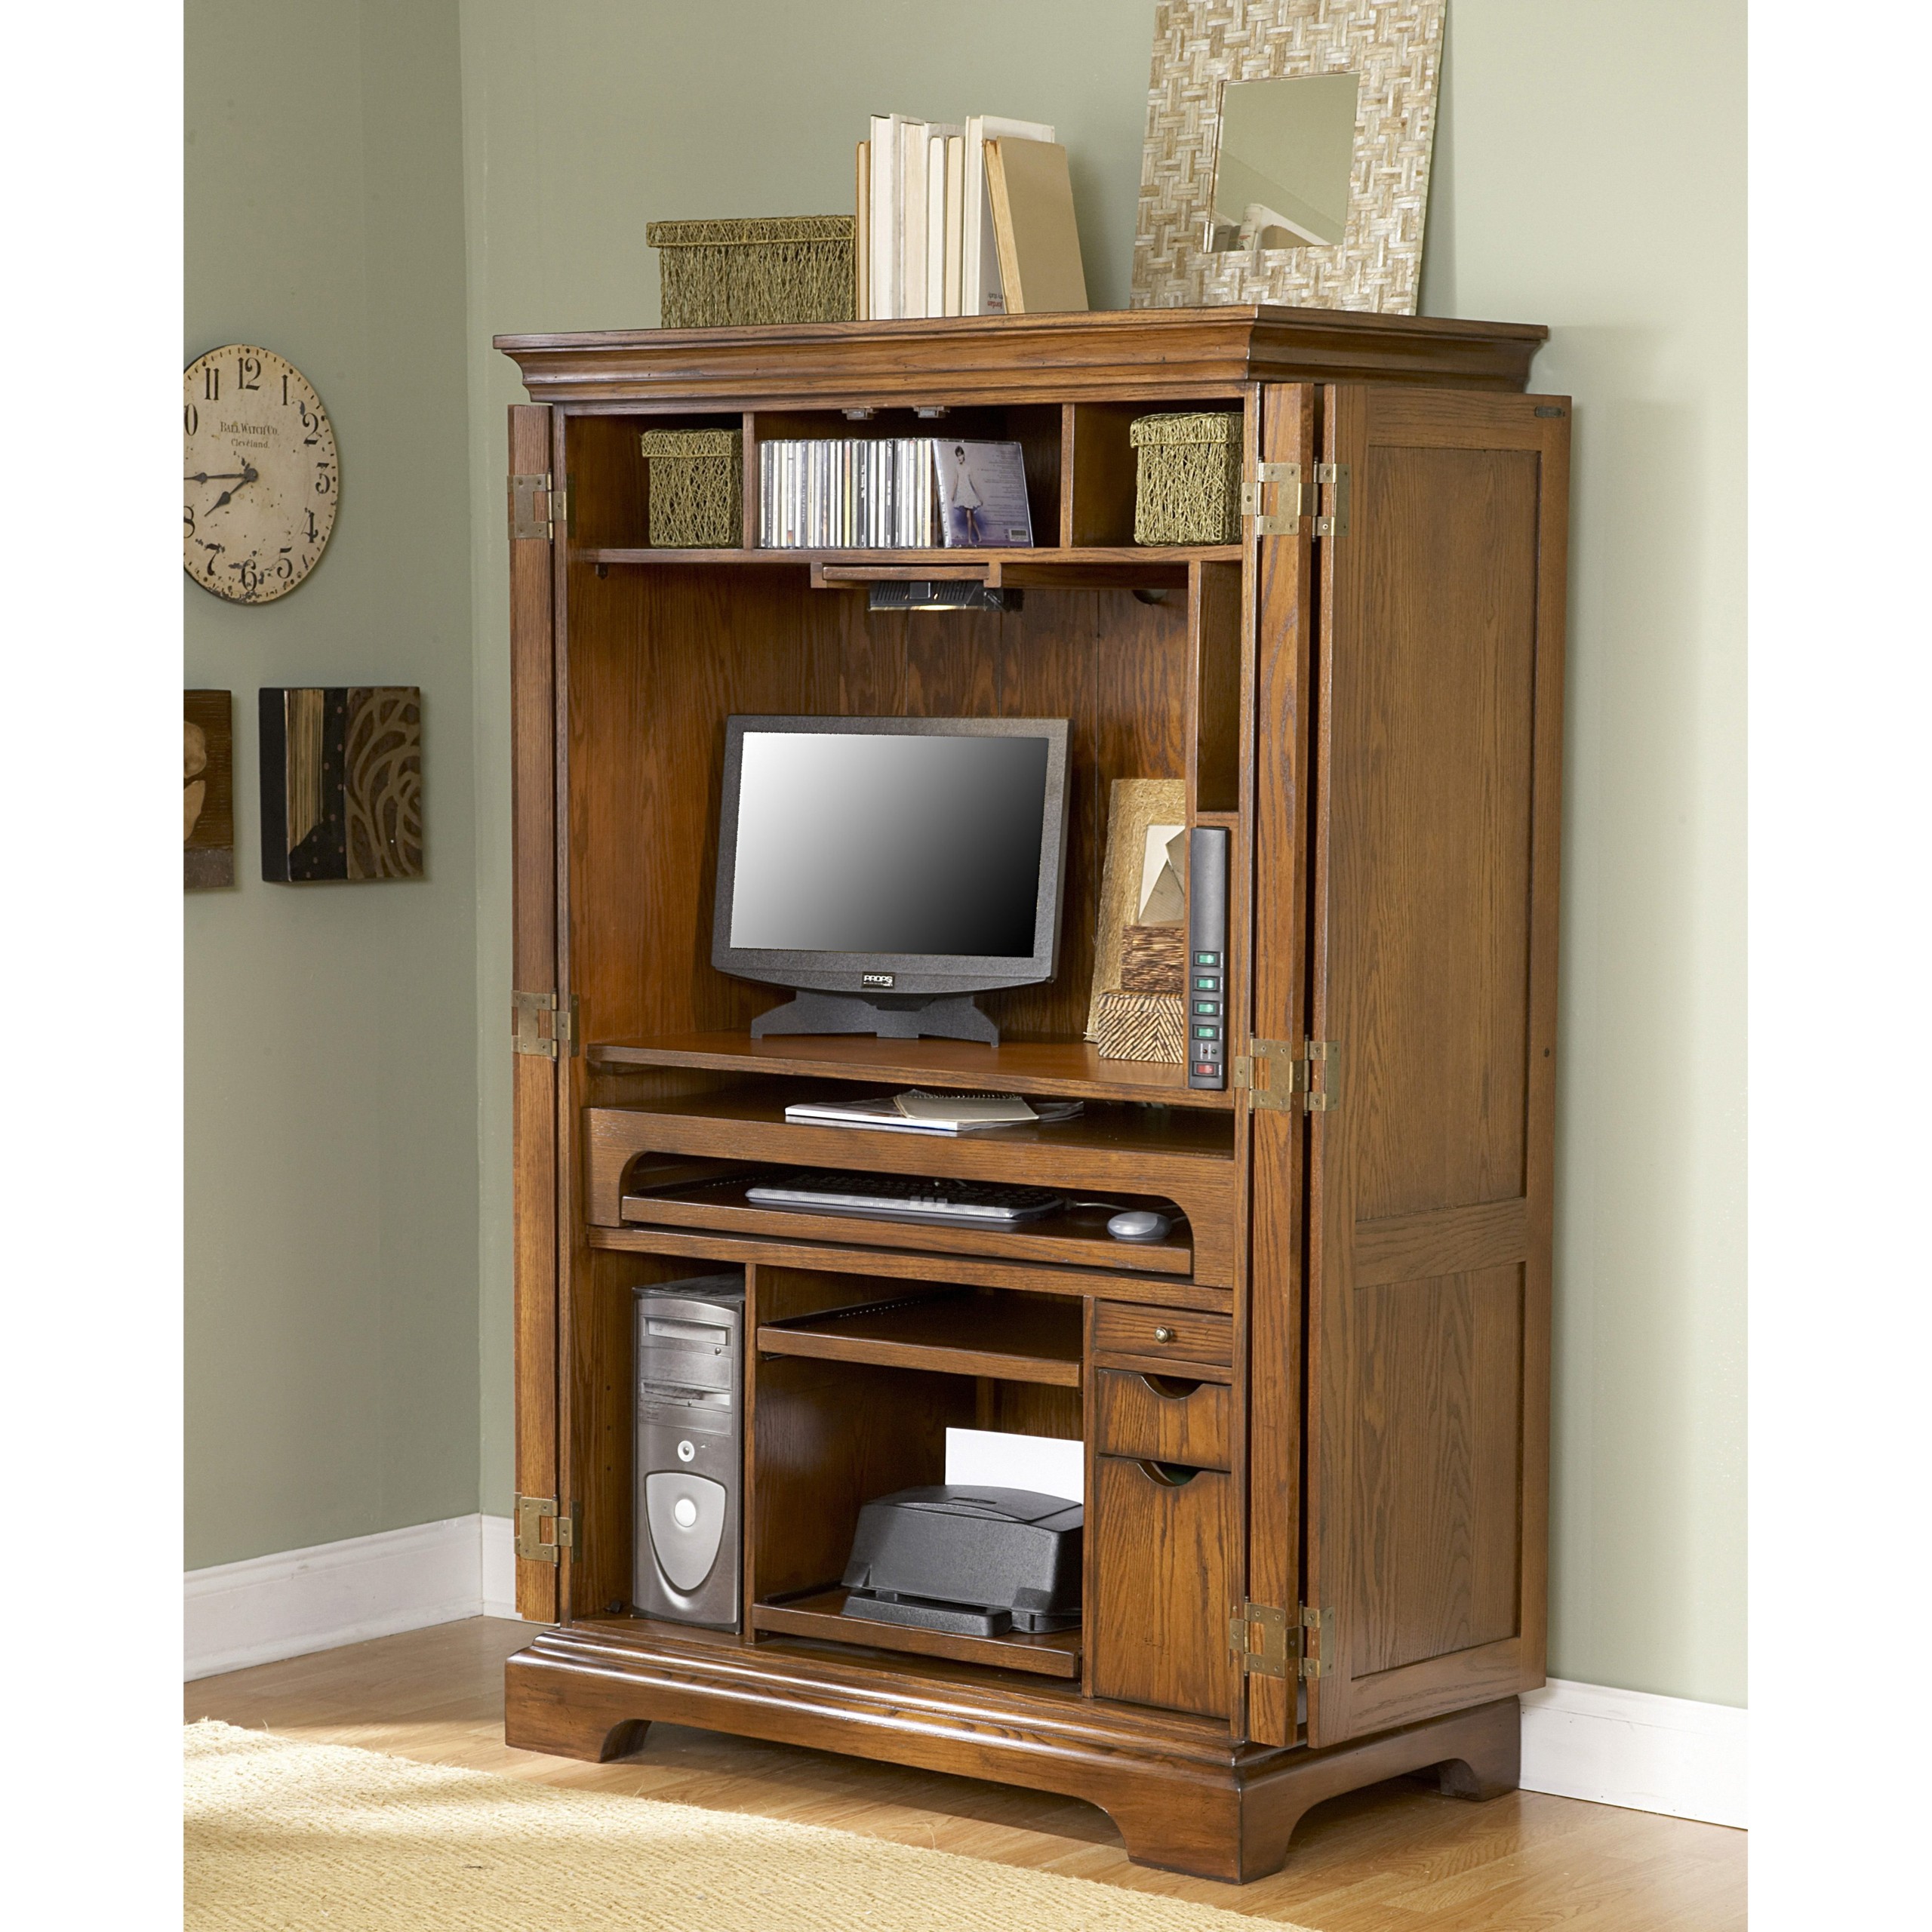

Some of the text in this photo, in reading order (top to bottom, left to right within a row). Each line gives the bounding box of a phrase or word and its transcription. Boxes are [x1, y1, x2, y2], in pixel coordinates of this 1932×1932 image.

[205, 368, 220, 401] 11
[238, 357, 261, 391] 12
[281, 374, 288, 406] 1
[183, 403, 198, 436] 0
[303, 412, 318, 445] 2
[315, 462, 331, 494] 3
[301, 512, 318, 543] 4
[205, 543, 222, 577] 7
[242, 559, 257, 591] 6
[276, 546, 293, 580] 5
[863, 975, 894, 984] PROPS
